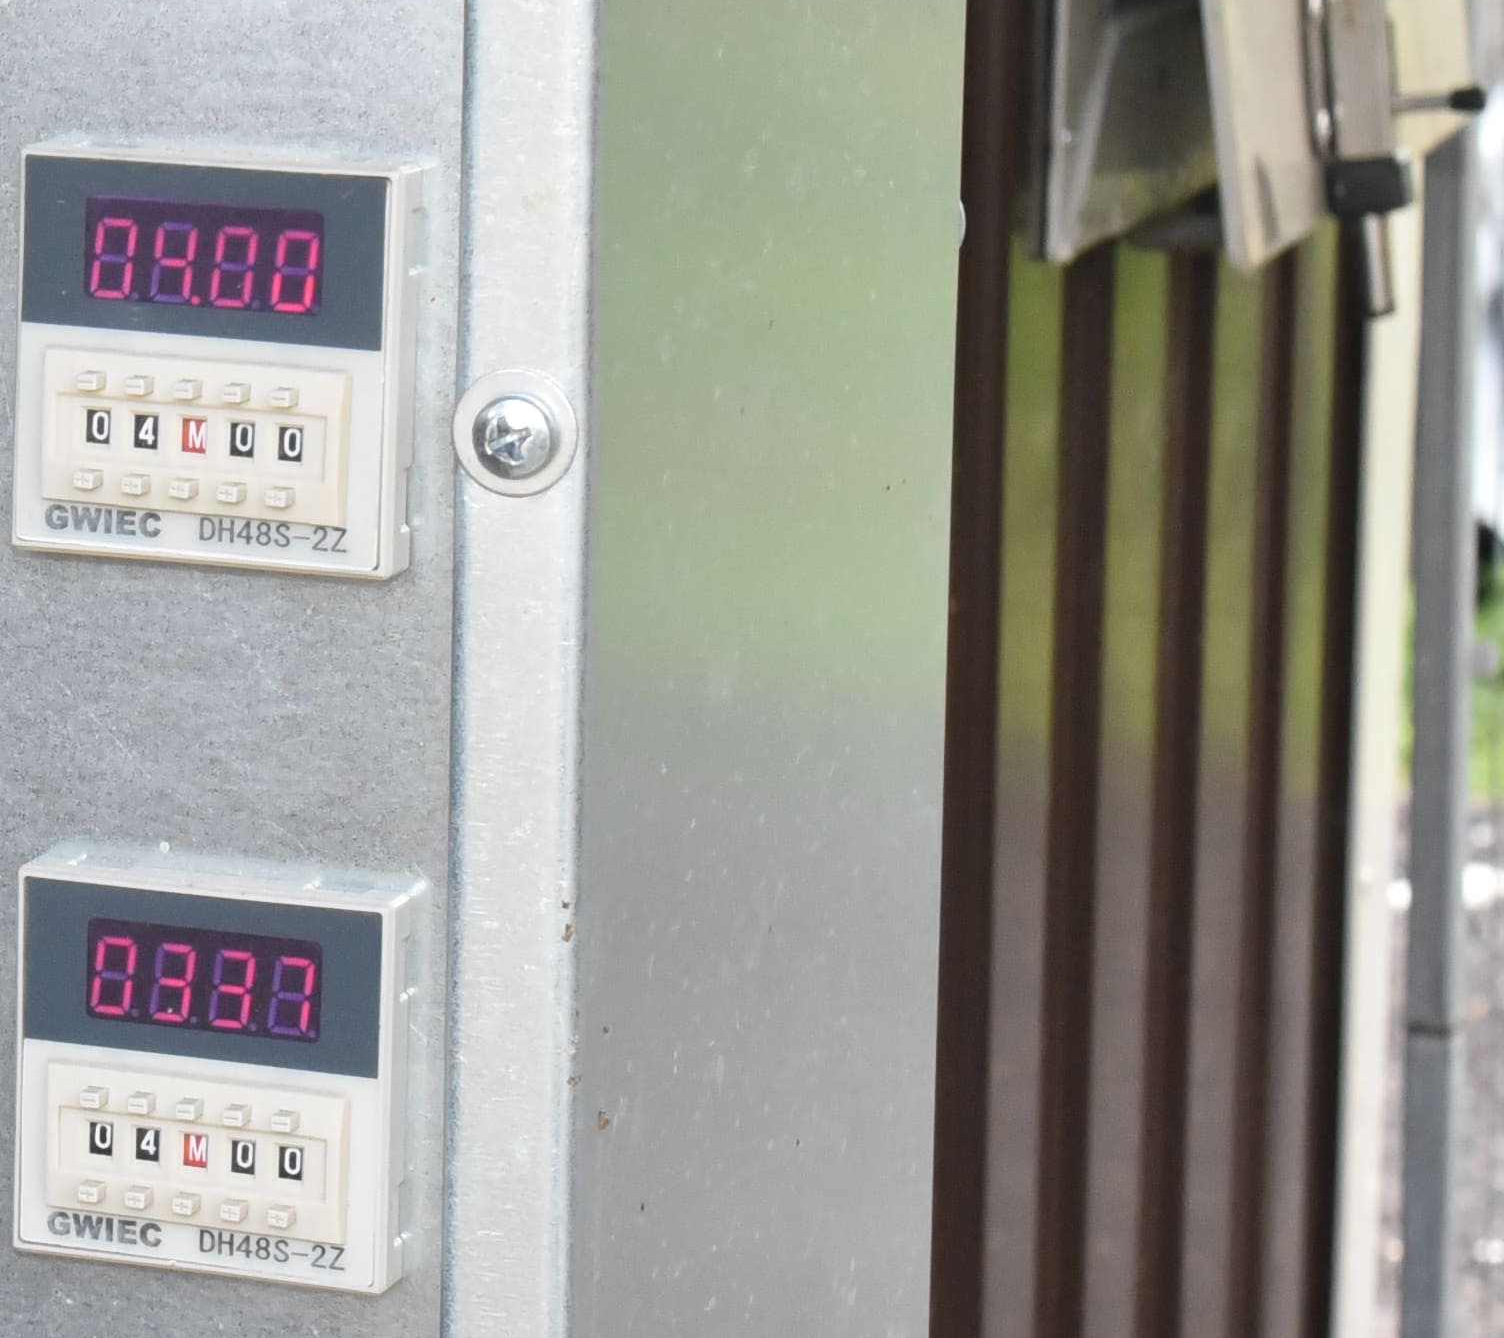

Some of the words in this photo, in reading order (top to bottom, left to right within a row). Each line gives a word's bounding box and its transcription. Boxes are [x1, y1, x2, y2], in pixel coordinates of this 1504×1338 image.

[45, 505, 162, 539] GWIEC
[198, 518, 348, 553] DH48S-2Z
[91, 936, 316, 1036] 0337
[47, 1212, 162, 1248] GWIEC
[198, 1229, 346, 1271] DH48S-2Z
